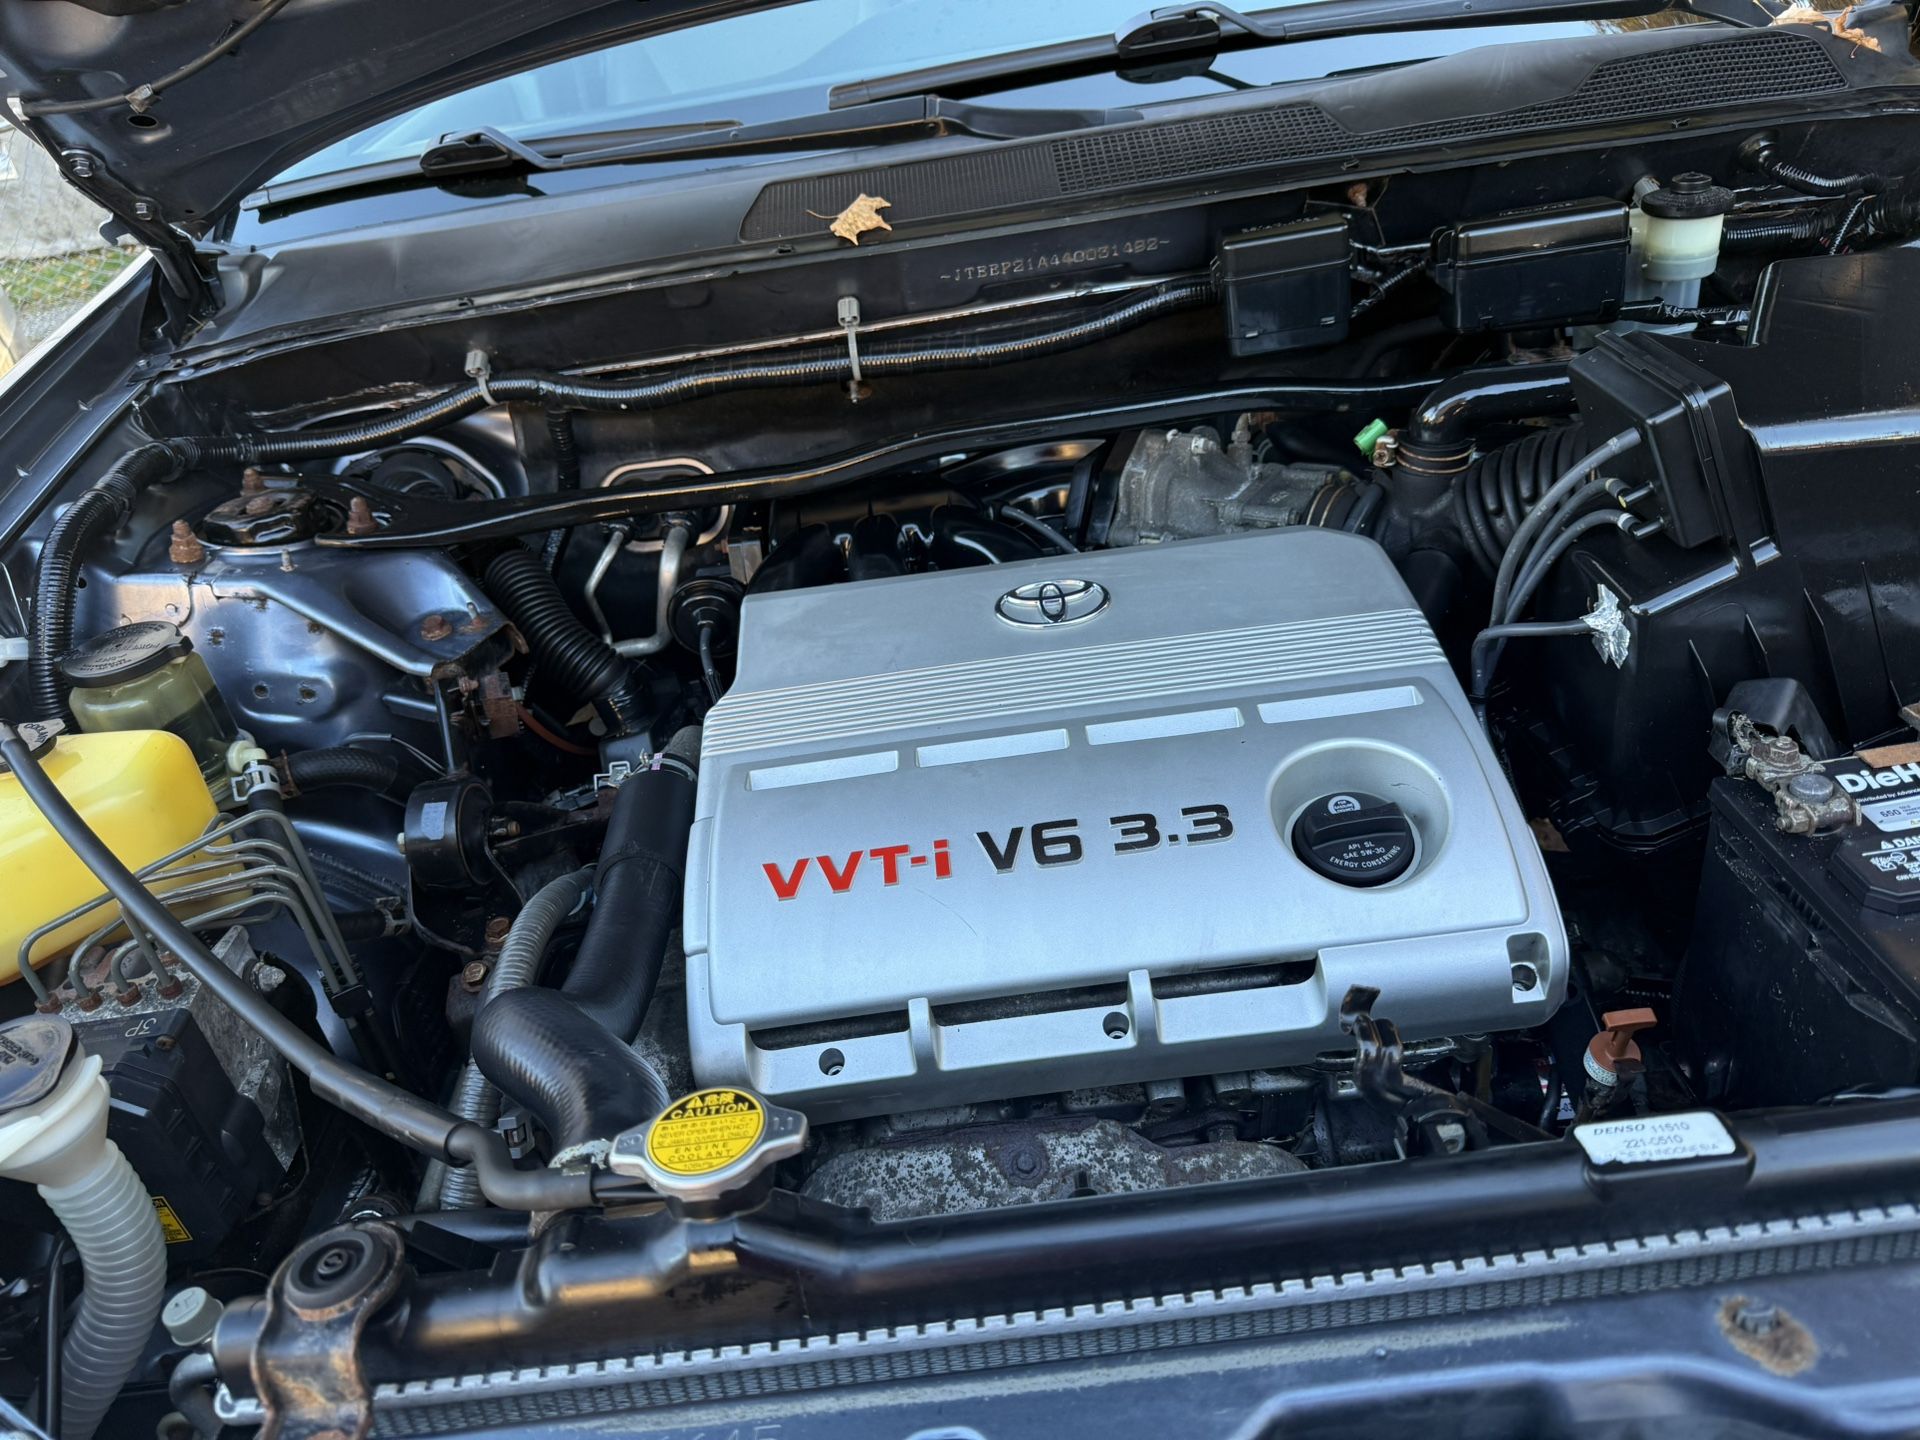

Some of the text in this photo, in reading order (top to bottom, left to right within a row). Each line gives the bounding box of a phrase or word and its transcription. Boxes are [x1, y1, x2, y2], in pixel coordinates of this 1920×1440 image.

[762, 803, 1235, 901] VVT-i V6 3.3
[1348, 842, 1360, 850] API
[1329, 845, 1401, 868] ENERGY CONSERVING
[1343, 847, 1385, 859] SAE 5W-30
[670, 1102, 749, 1120] CAUTION
[686, 1127, 708, 1137] OPEN
[710, 1125, 730, 1134] WHEN
[1593, 1123, 1645, 1136] DENSO
[674, 1142, 729, 1154] ENGINE
[668, 1149, 733, 1162] COOLANT
